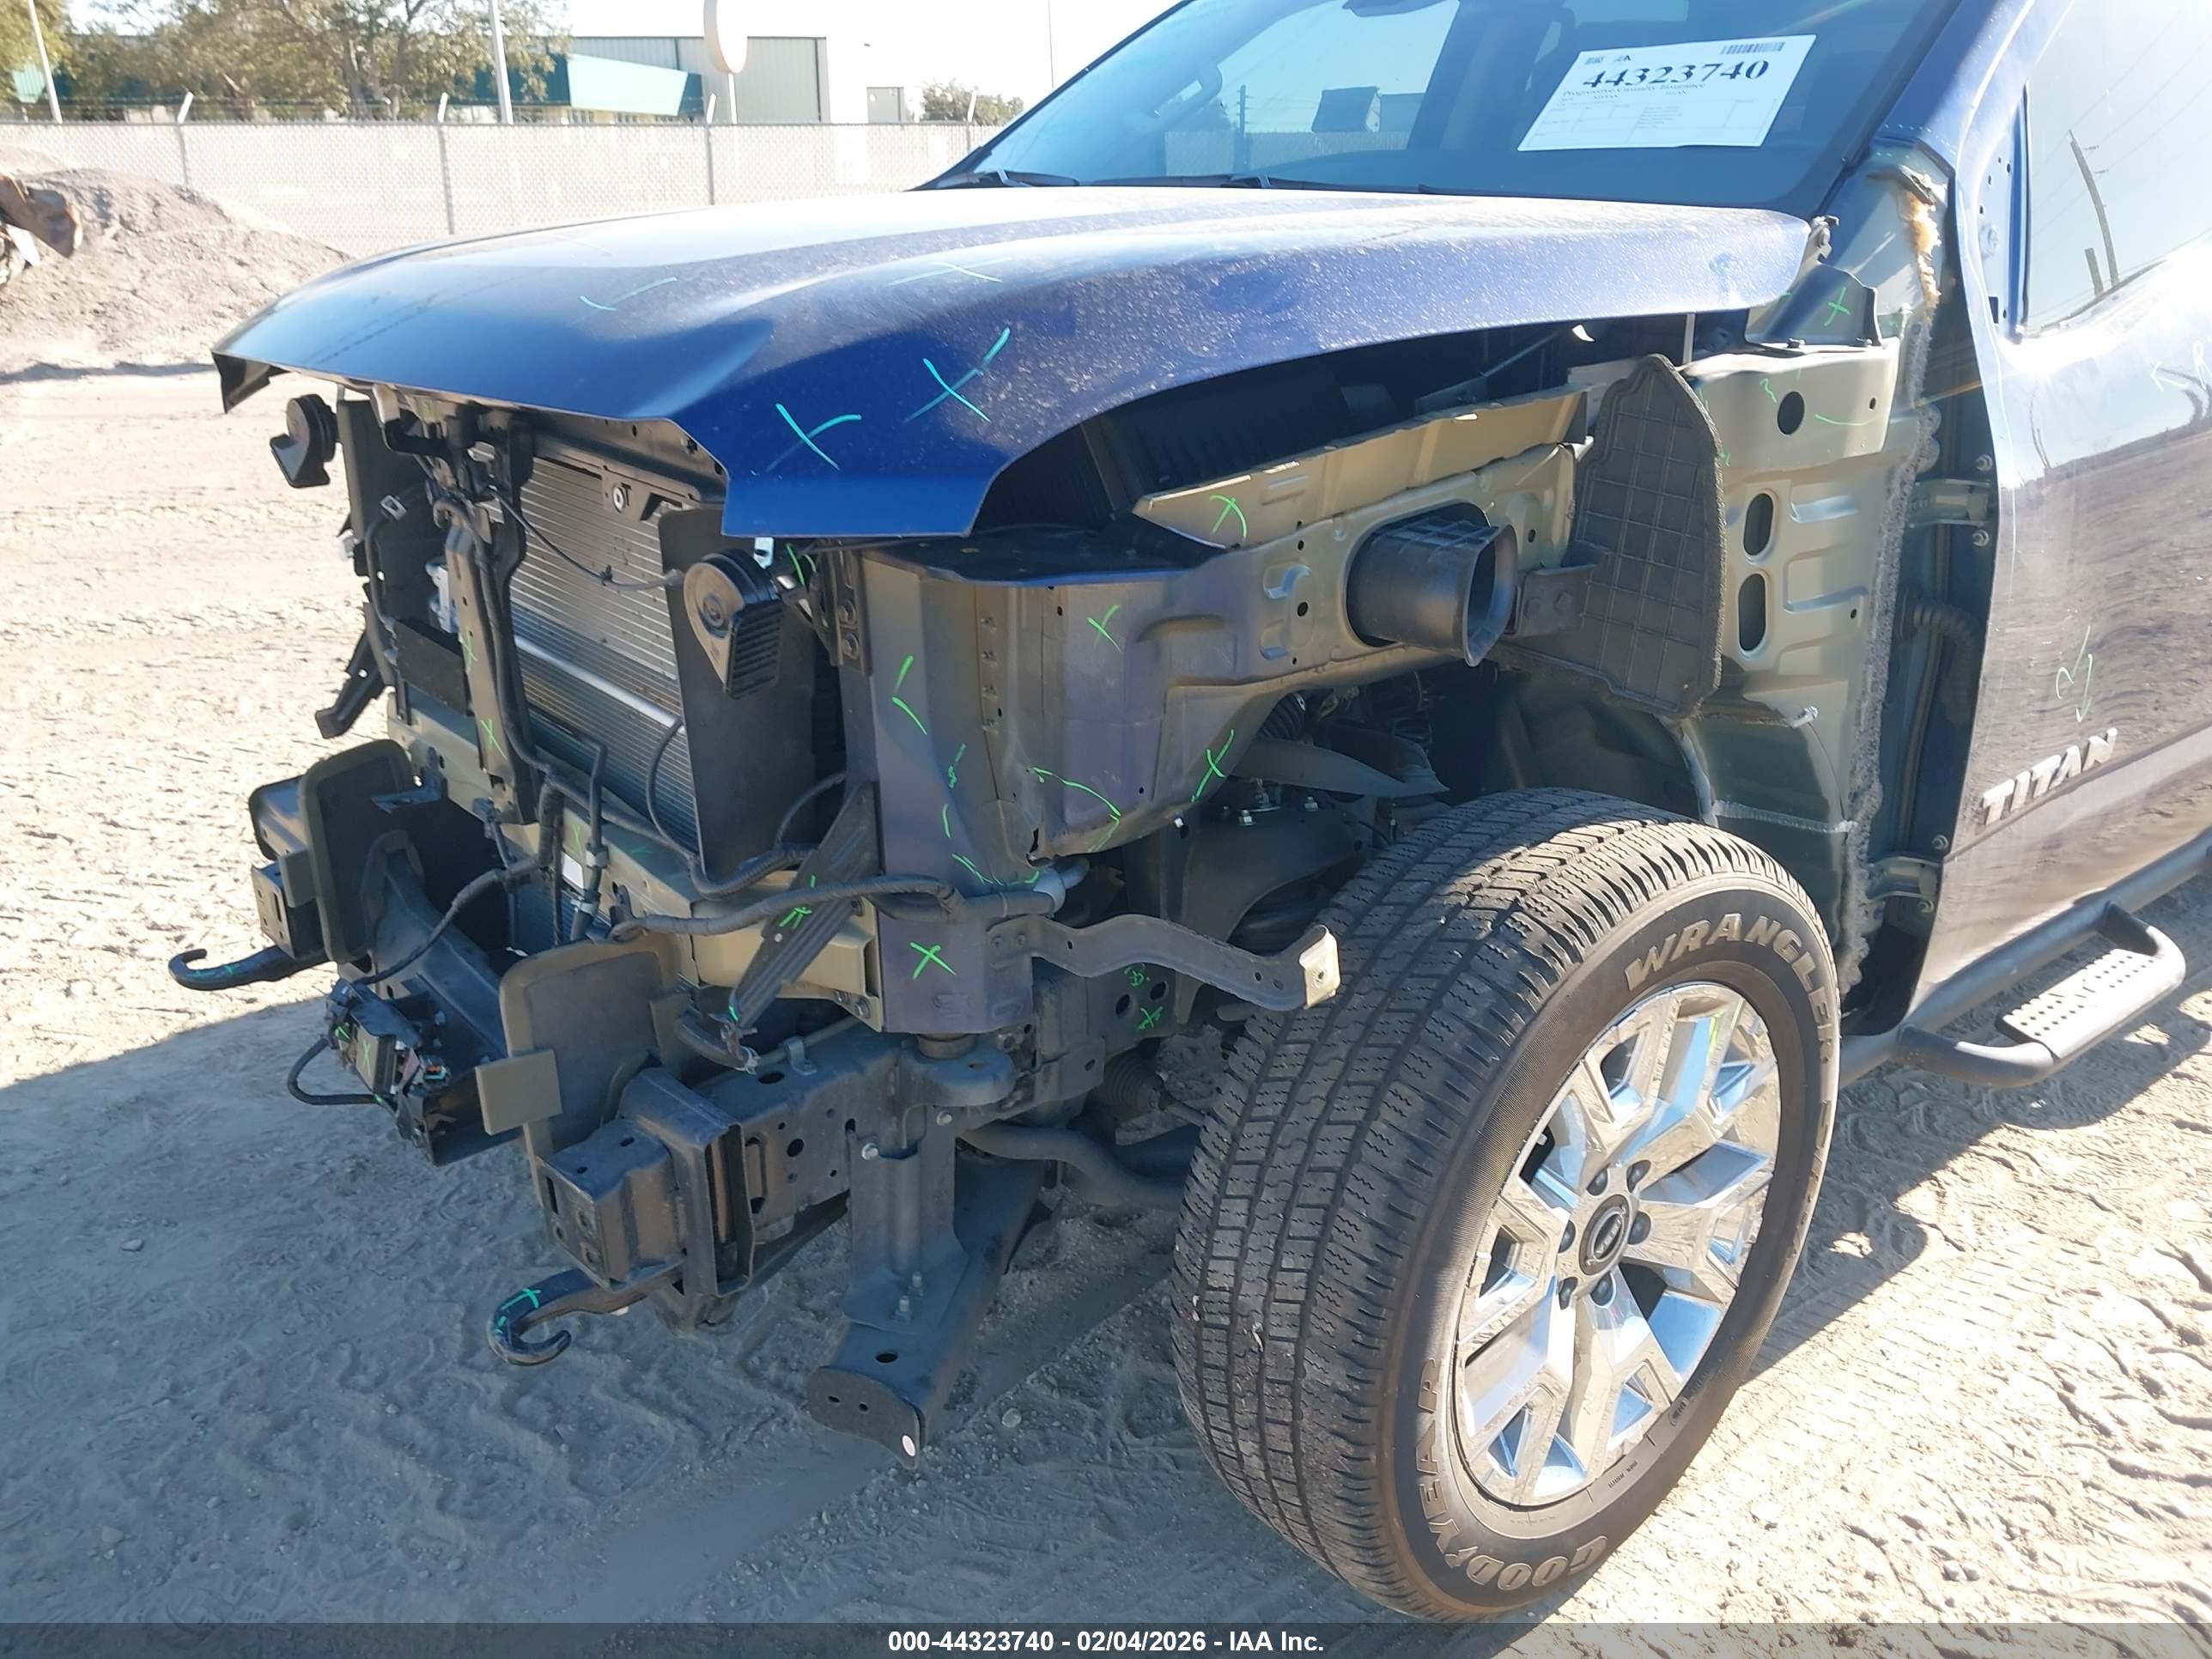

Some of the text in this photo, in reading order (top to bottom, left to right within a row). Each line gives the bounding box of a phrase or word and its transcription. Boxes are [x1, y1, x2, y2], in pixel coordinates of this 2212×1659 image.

[1582, 58, 1770, 88] 44323740
[1982, 727, 2118, 826] TITAN
[1624, 912, 1834, 1066] WRANGLER
[1415, 1356, 1608, 1591] GOODYEAR
